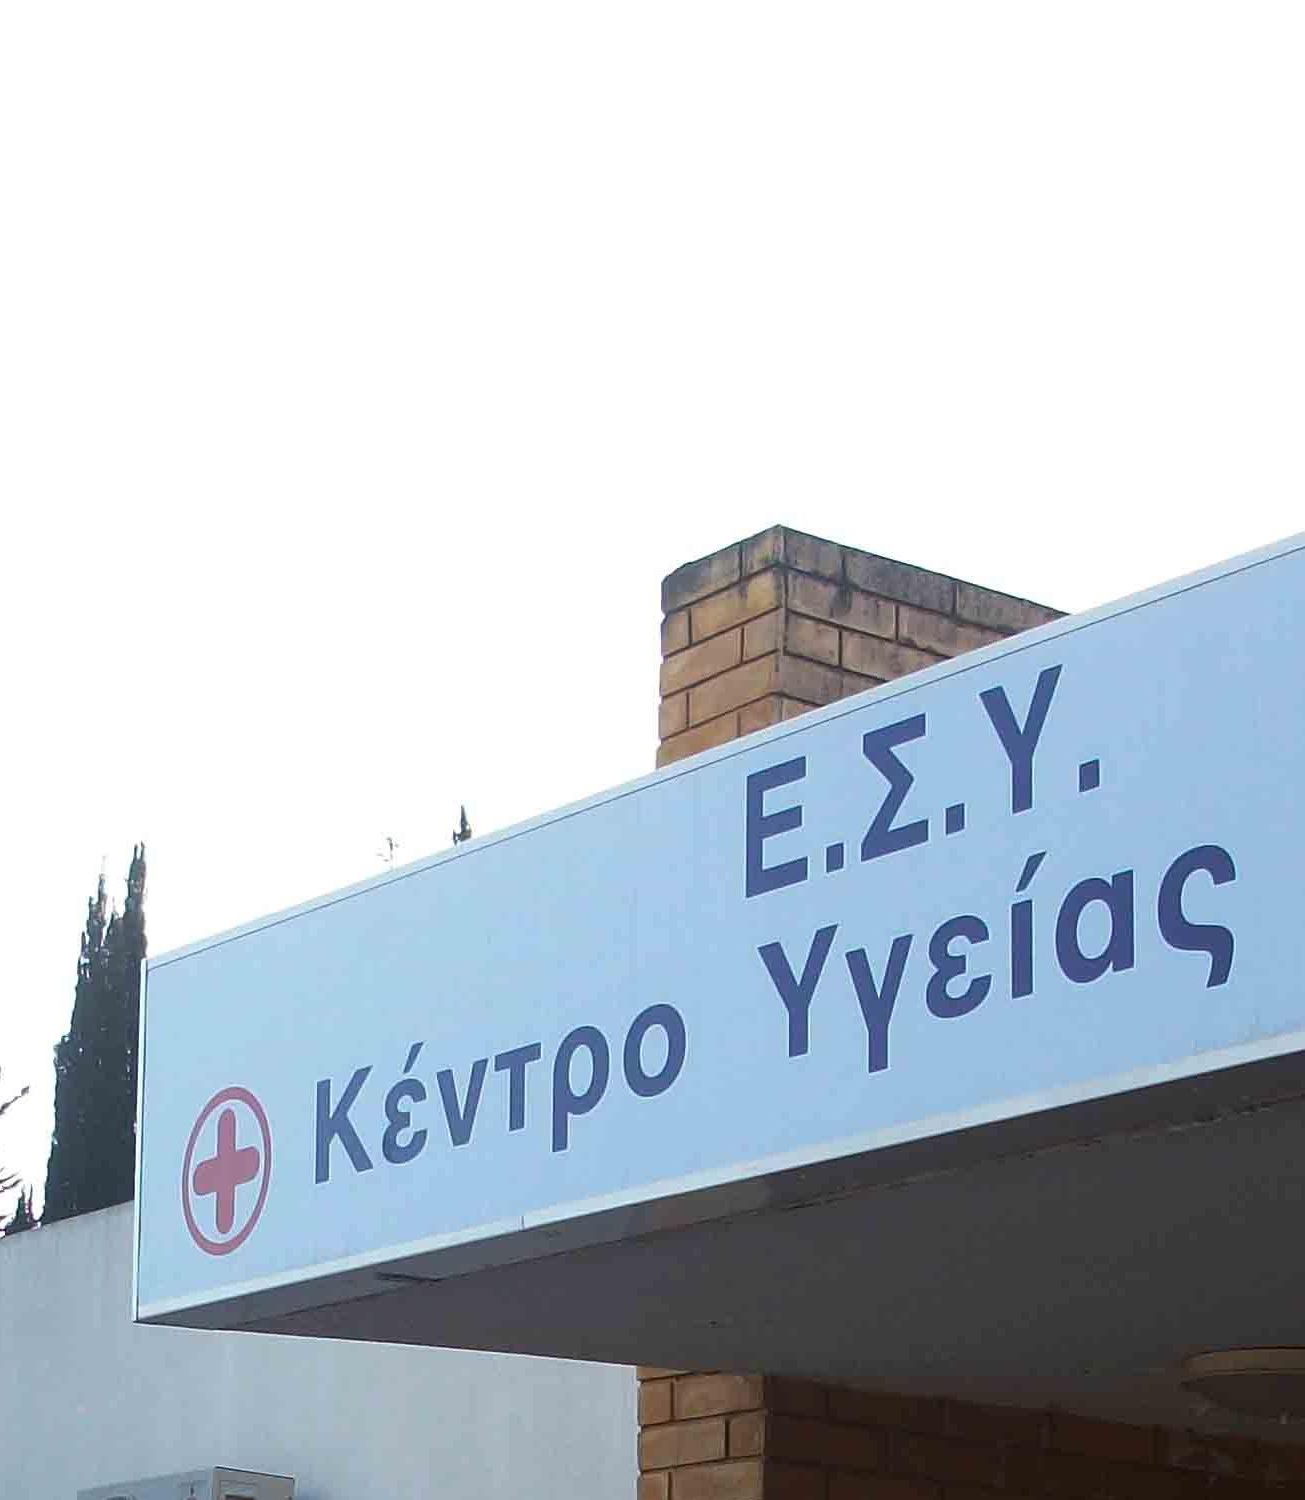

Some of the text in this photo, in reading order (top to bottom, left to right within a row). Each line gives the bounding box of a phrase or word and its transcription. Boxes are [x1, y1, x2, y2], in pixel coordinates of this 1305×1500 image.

[744, 663, 1101, 899] Ε.Σ.Υ.
[314, 844, 1237, 1185] Κέντρο Υγείας
